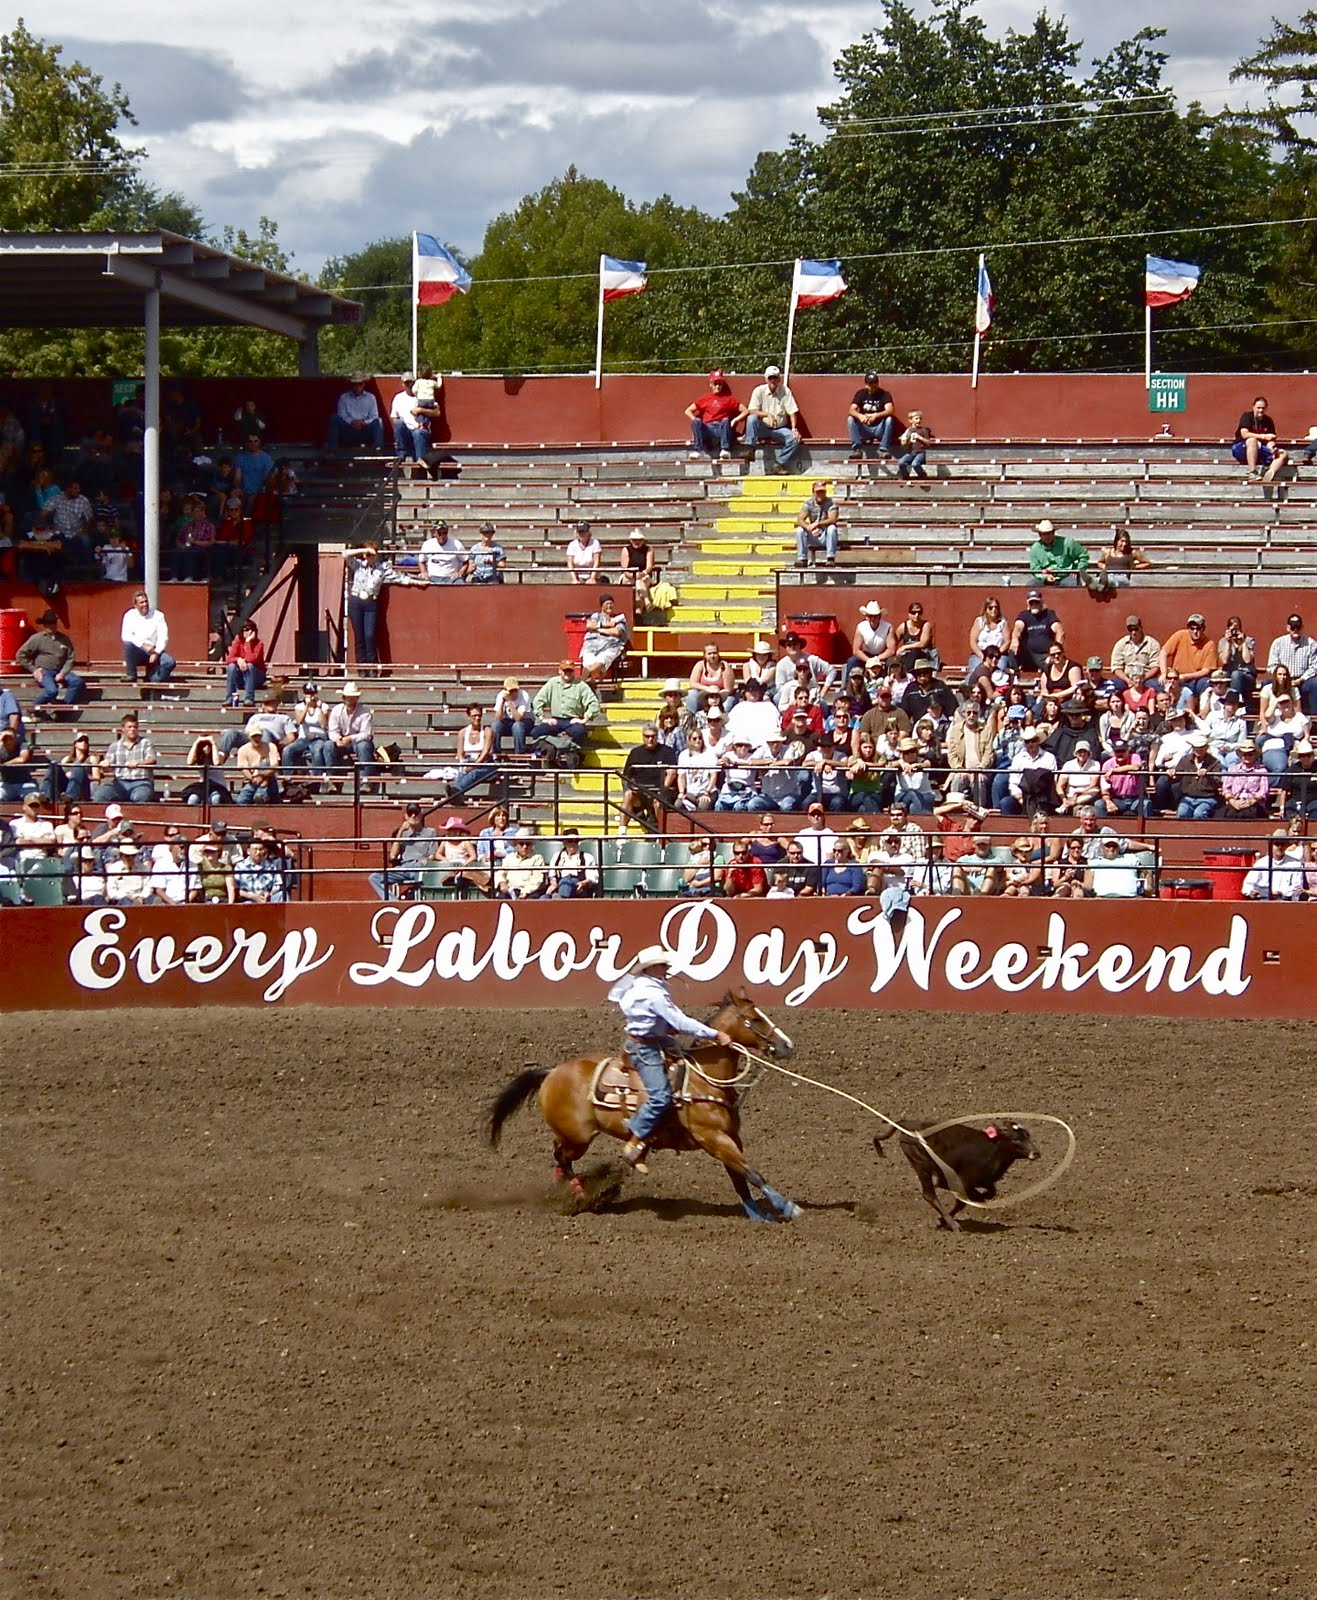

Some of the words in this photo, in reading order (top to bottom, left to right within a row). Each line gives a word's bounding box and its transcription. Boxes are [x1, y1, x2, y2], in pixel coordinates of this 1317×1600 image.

[1151, 379, 1185, 389] SECTION
[1156, 392, 1179, 408] HH
[781, 482, 788, 491] N
[69, 907, 335, 1002] Every
[349, 902, 639, 987] Labor
[660, 899, 849, 1007] Day
[847, 905, 1252, 996] Weekend
